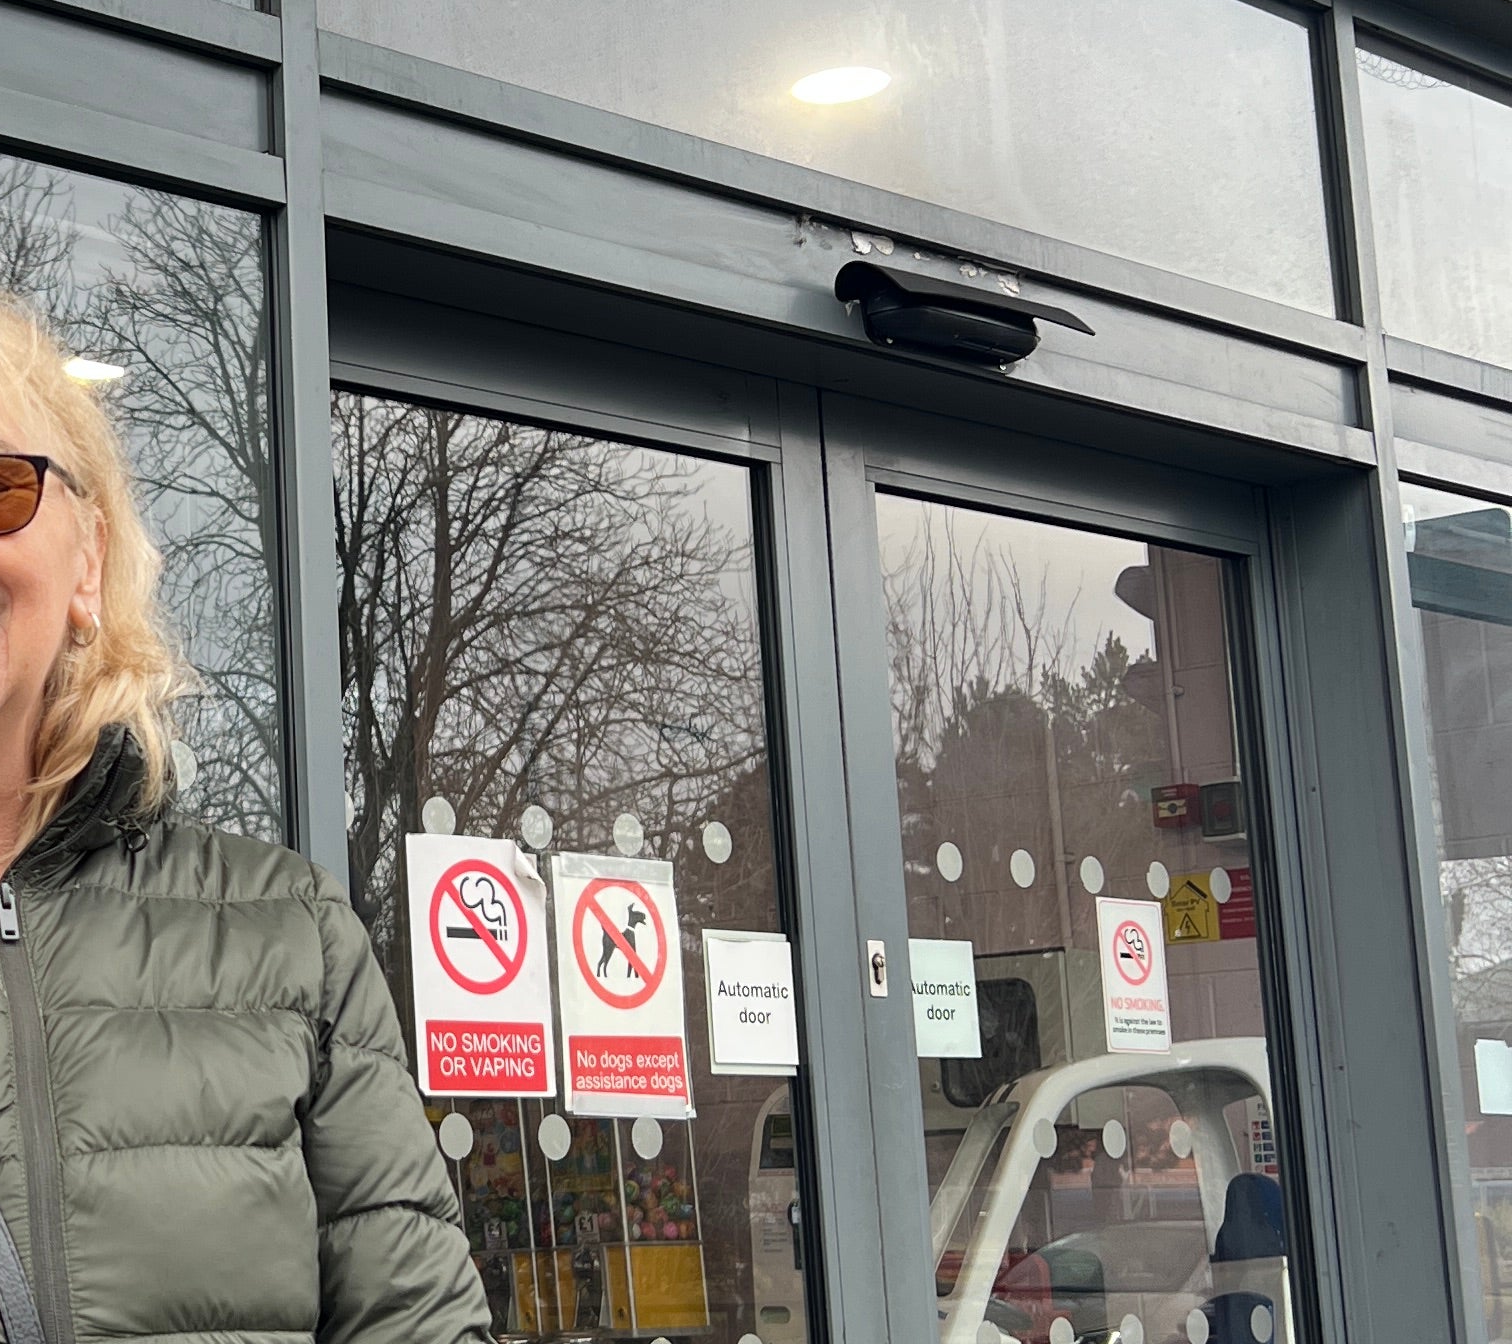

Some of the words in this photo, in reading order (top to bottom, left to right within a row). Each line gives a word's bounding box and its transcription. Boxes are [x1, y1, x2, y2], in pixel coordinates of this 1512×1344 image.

[718, 980, 789, 1000] Automatic
[927, 1004, 956, 1021] door
[1111, 997, 1123, 1010] NO
[739, 1006, 772, 1025] door
[431, 1032, 457, 1052] NO
[462, 1033, 541, 1055] SMOKING
[440, 1057, 466, 1077] OR
[471, 1057, 535, 1078] VAPING
[577, 1050, 597, 1068] No
[600, 1050, 633, 1072] dogs
[637, 1053, 680, 1073] except
[576, 1073, 647, 1090] assistance
[651, 1073, 683, 1092] dogs
[578, 1215, 594, 1233] £1
